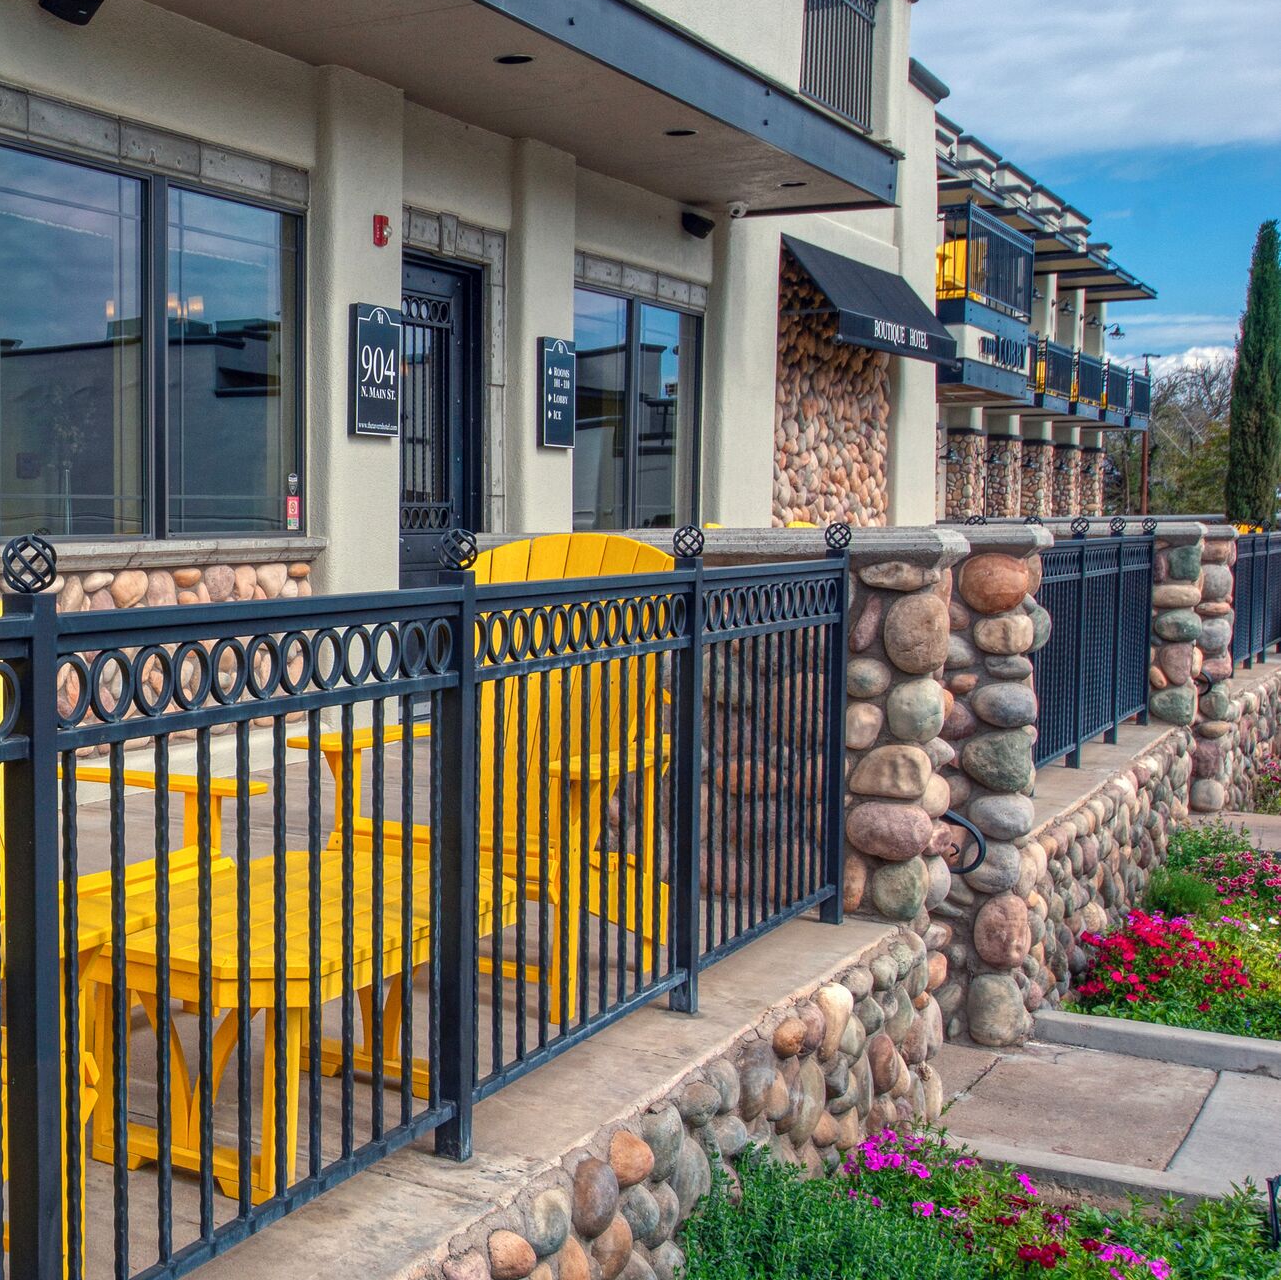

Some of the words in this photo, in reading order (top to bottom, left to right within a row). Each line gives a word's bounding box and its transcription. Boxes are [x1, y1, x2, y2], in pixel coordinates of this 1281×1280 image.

[874, 319, 906, 347] BOUTIQUE
[909, 328, 929, 350] HOTEL
[360, 344, 396, 386] 904
[553, 366, 570, 379] ROOMS
[360, 385, 369, 398] N.
[369, 386, 387, 400] MAIN
[386, 388, 397, 401] ST.
[553, 393, 568, 405] LOBBY
[553, 409, 562, 421] ICE
